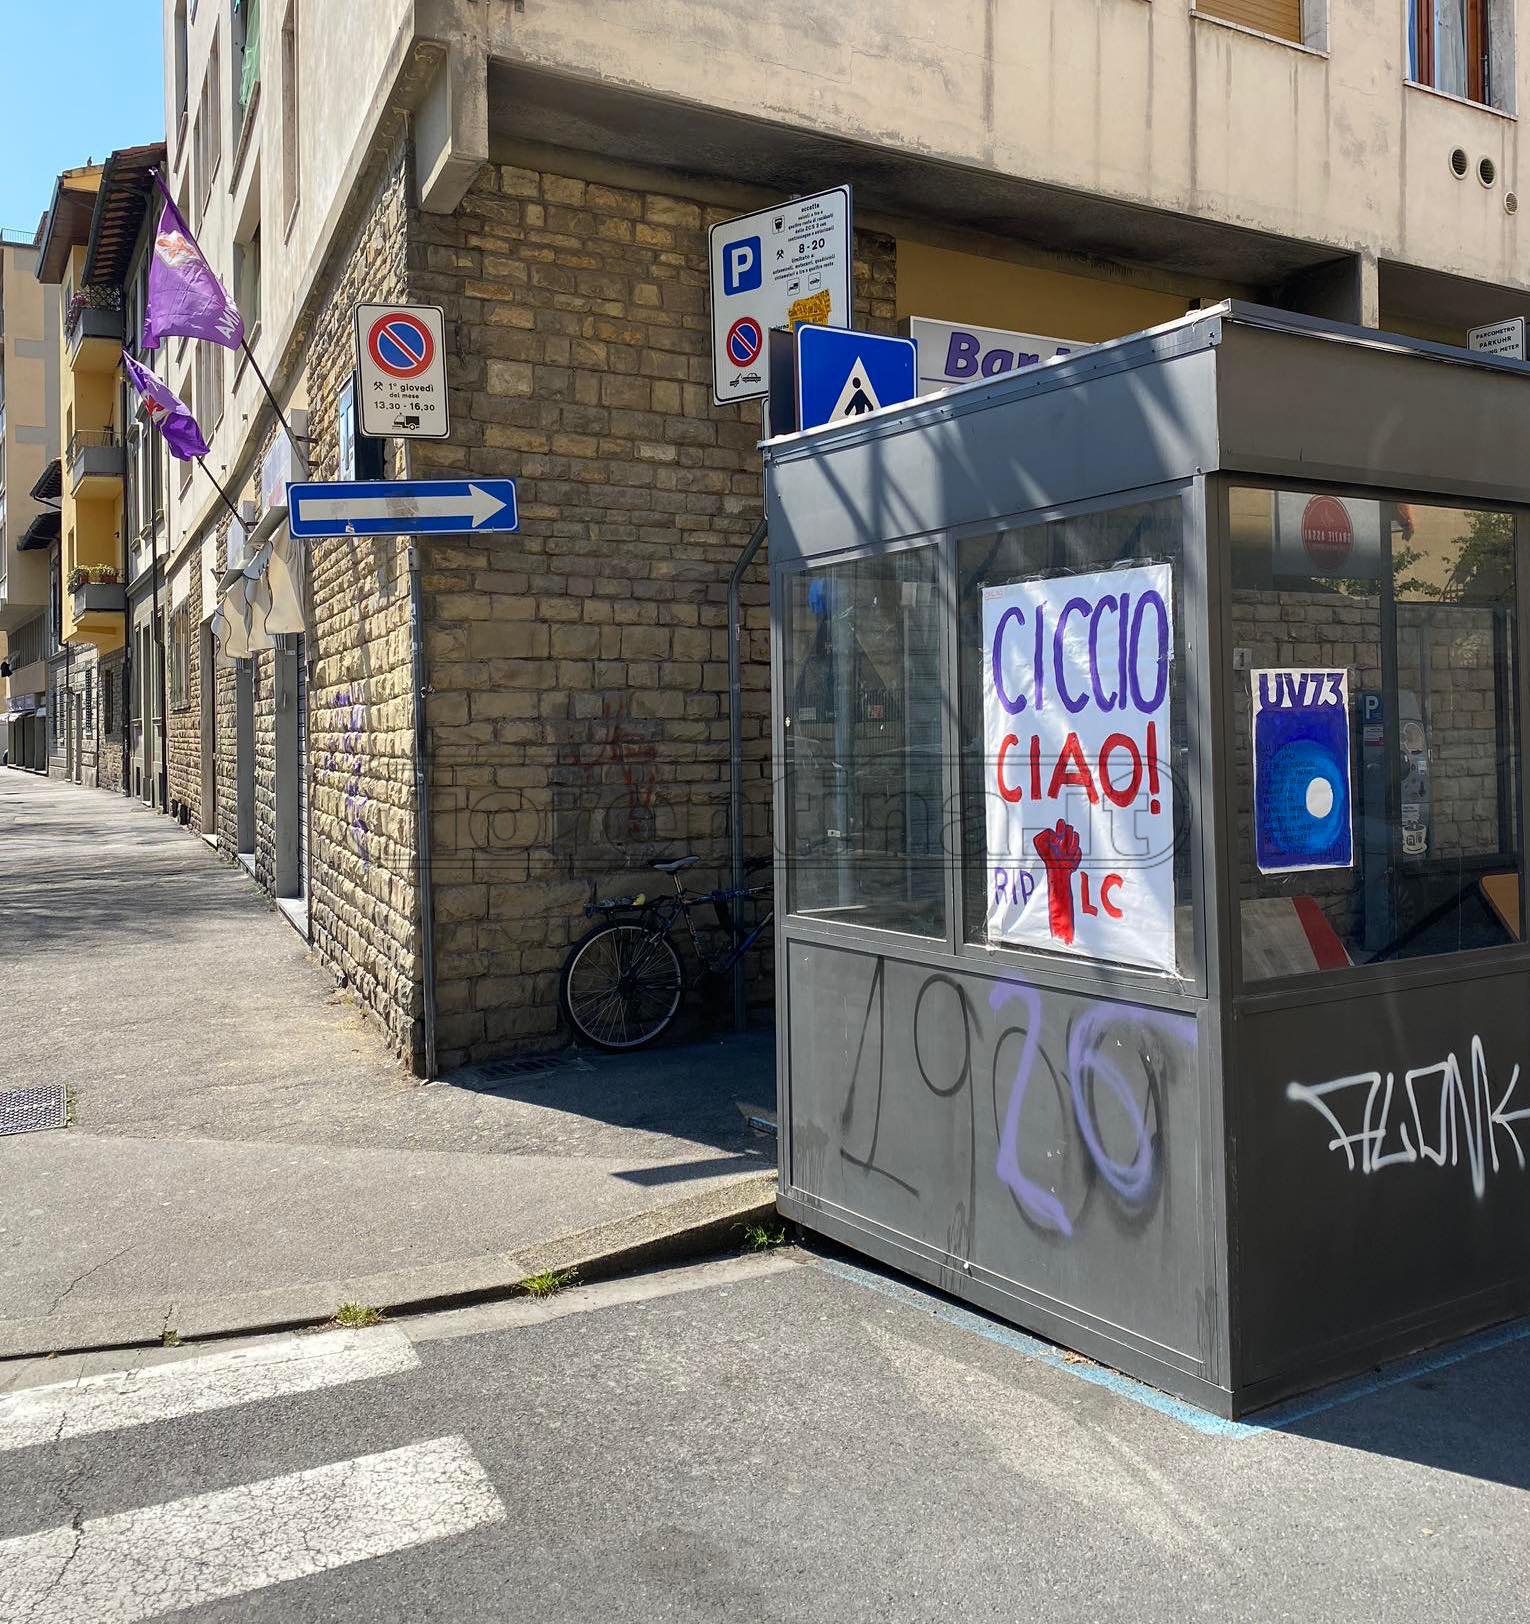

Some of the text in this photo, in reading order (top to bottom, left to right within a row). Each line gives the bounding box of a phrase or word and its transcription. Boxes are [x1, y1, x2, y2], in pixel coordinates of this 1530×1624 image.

[731, 246, 754, 288] P
[1480, 336, 1512, 348] PARKUHR
[374, 401, 400, 410] 13.30
[410, 402, 435, 412] 16.30
[400, 384, 434, 392] giovedì
[992, 589, 1169, 715] CICCIO
[1258, 672, 1345, 707] UV73
[997, 721, 1161, 815] CIAO!
[994, 866, 1124, 919] RIP LC
